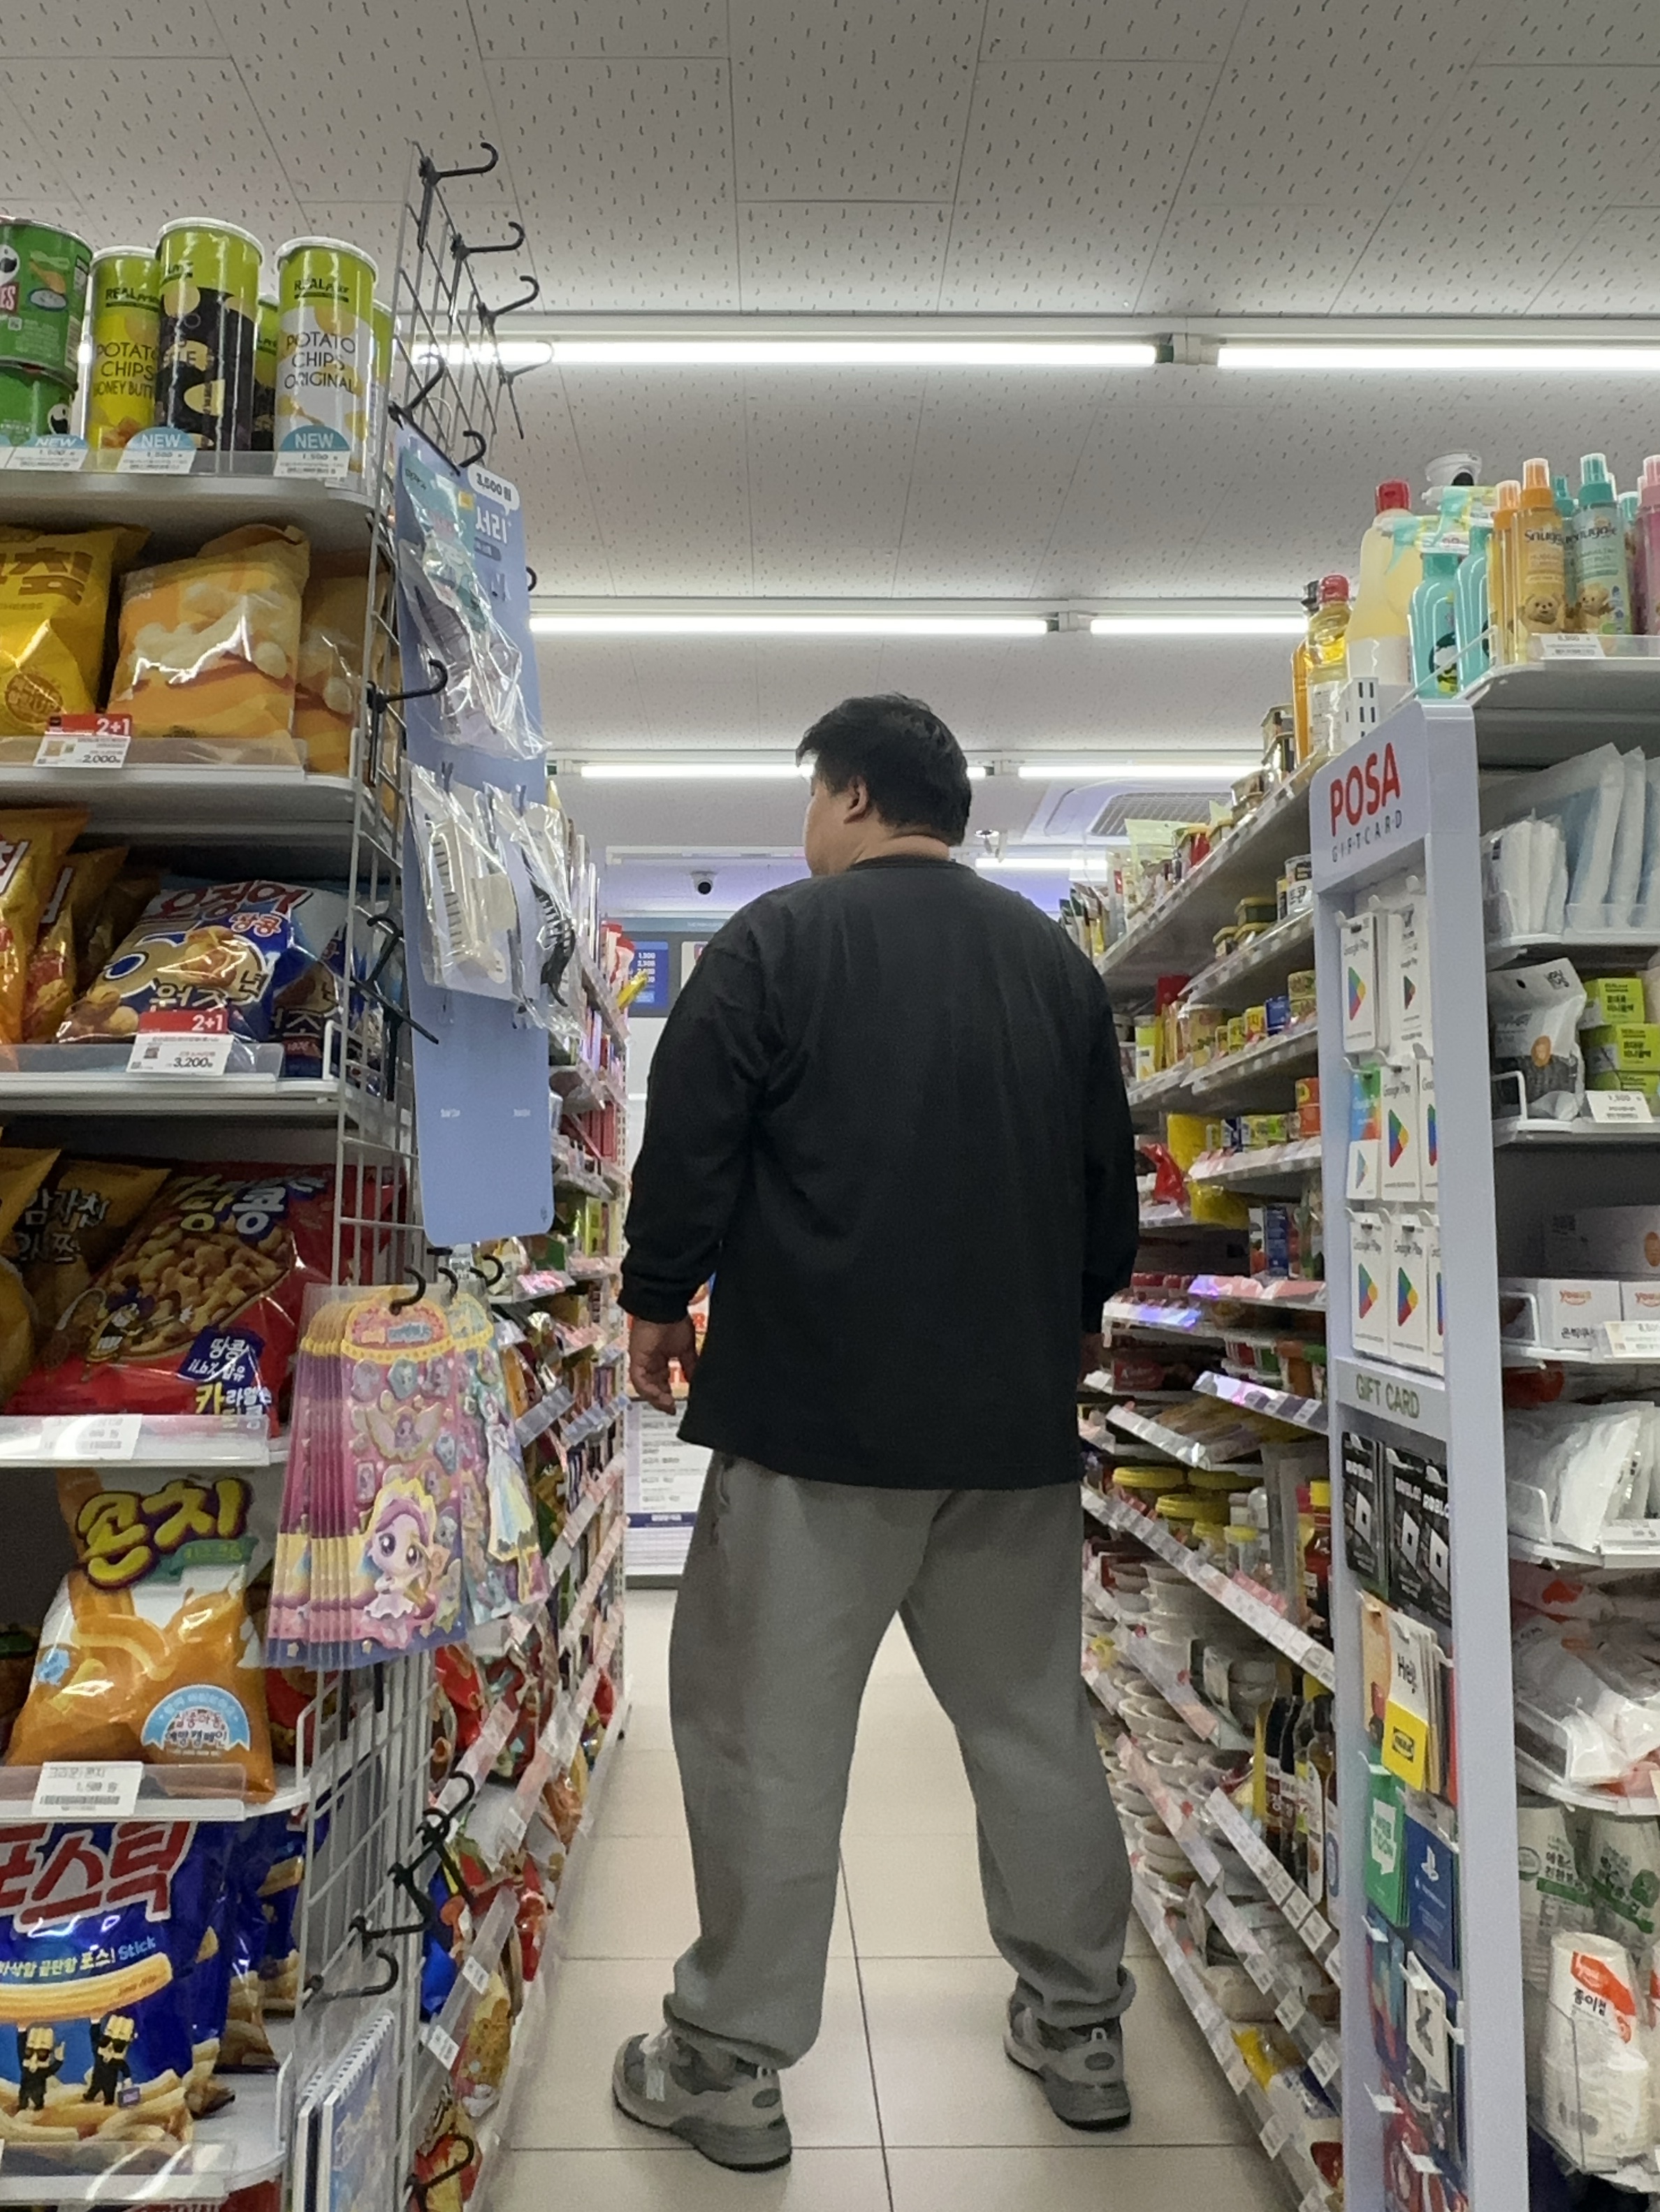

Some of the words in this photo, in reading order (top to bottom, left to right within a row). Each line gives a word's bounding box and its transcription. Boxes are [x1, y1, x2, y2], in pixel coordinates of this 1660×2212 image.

[286, 331, 356, 353] POTATO
[101, 360, 154, 381] CHIPS
[291, 351, 345, 371] CHIPS
[284, 372, 354, 394] ORIGINAL
[35, 439, 78, 447] NEW
[140, 434, 182, 448] NEW
[295, 433, 334, 449] NEW
[96, 718, 131, 735] 2+1
[1330, 742, 1401, 837] POSA
[143, 880, 307, 919] 오징어
[191, 1014, 224, 1031] 2+1
[209, 1336, 247, 1361] 땅콩
[1355, 1373, 1382, 1406] GIFT
[1385, 1382, 1420, 1419] CARD
[117, 1935, 156, 1961] Stick
